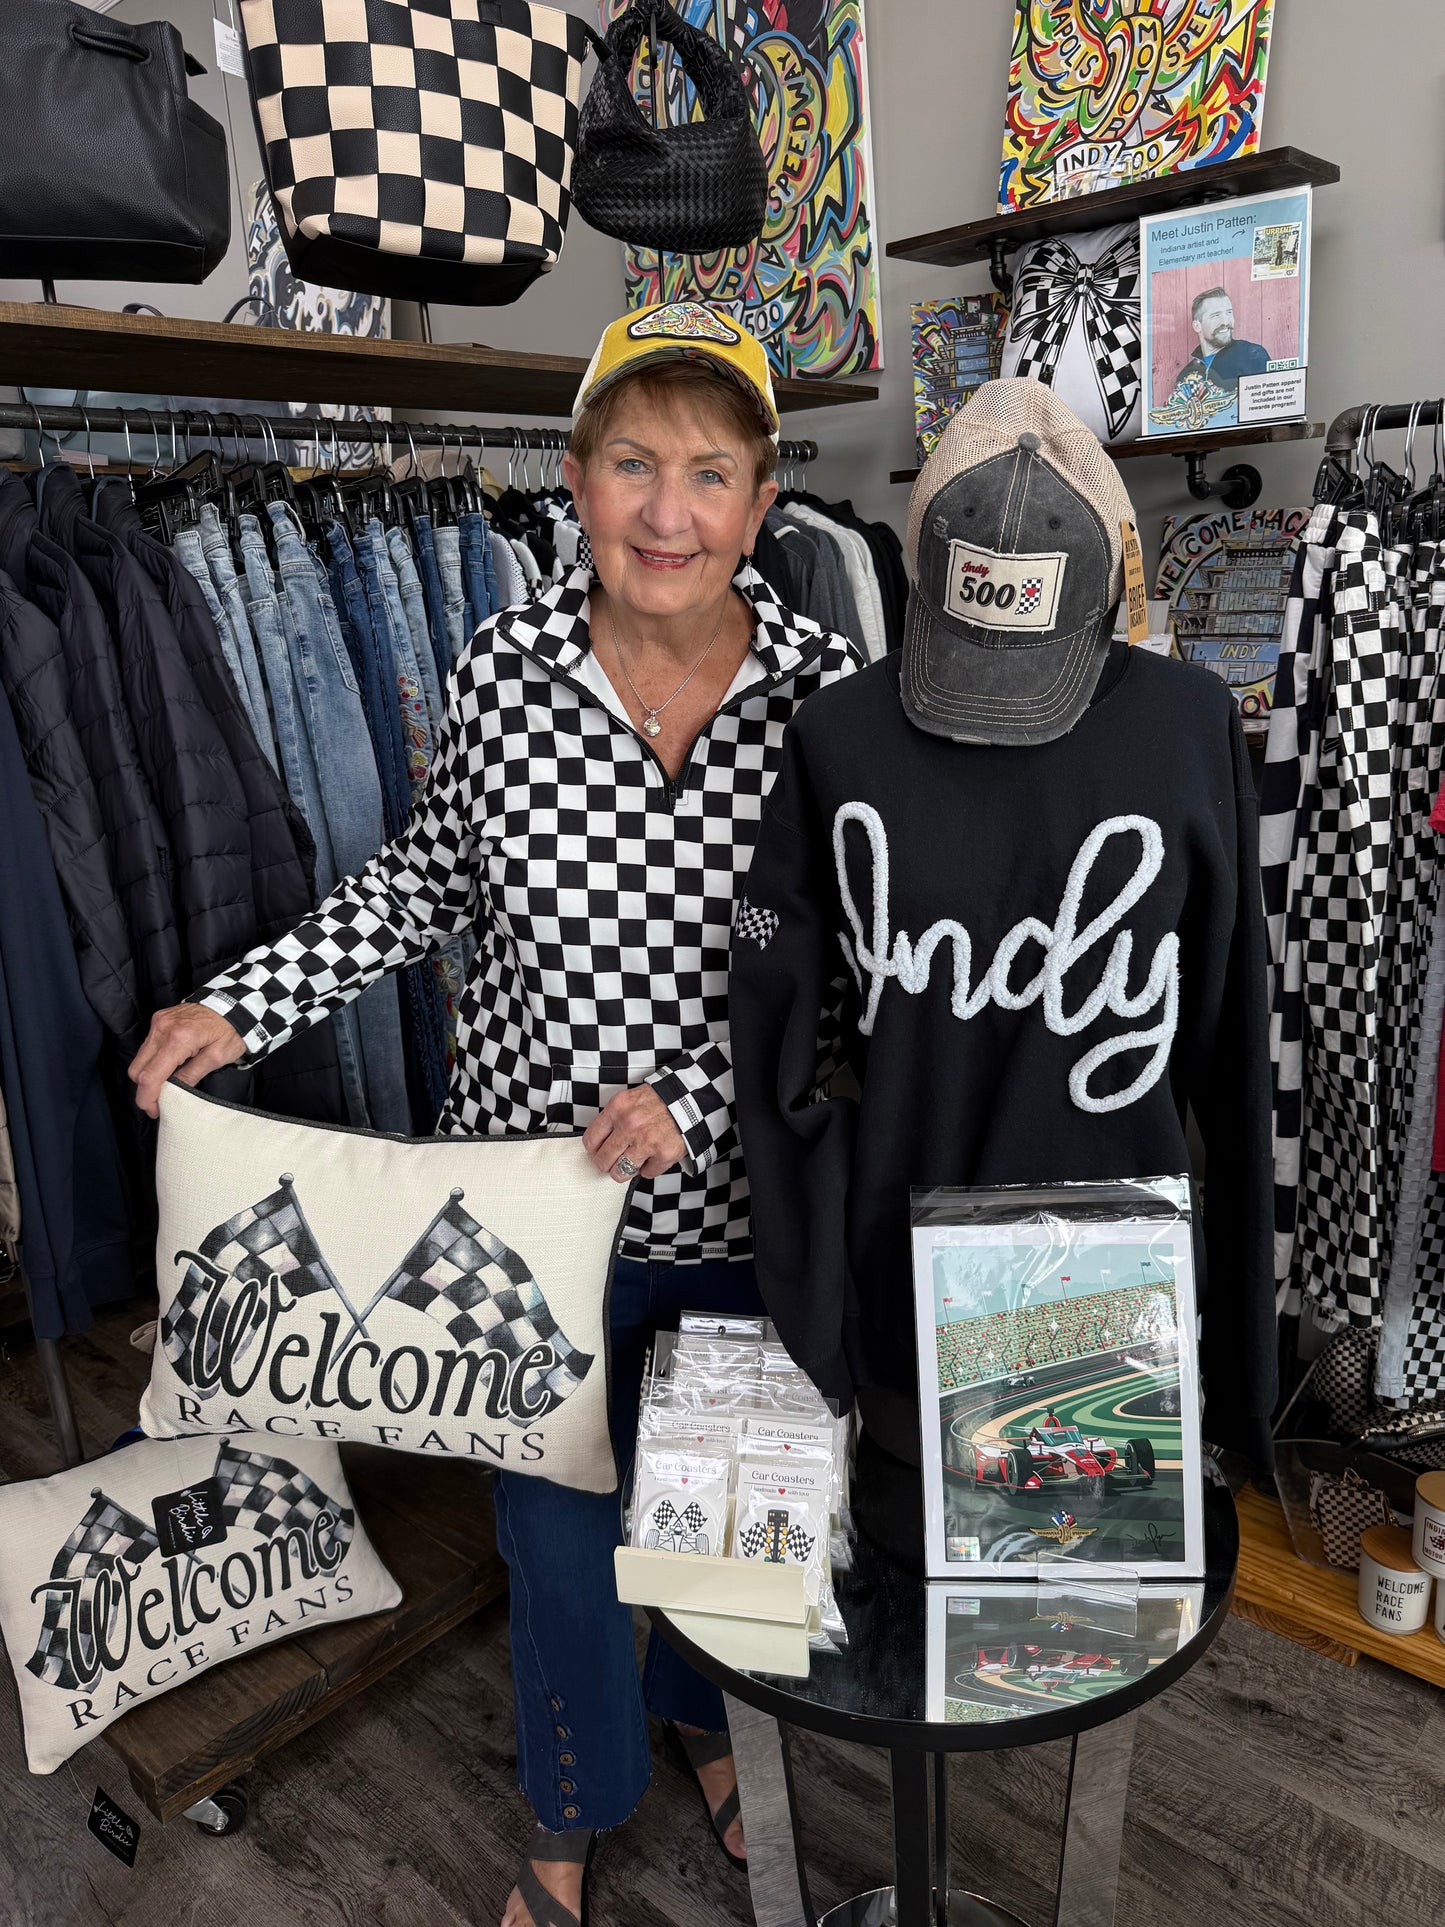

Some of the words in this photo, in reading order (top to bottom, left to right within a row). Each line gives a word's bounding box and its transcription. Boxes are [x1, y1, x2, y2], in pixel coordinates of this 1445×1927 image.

[1100, 21, 1158, 139] MOTOR
[768, 51, 812, 214] SPEEDWAY
[1062, 143, 1117, 173] INDY
[1151, 227, 1179, 242] Meet
[1181, 221, 1214, 237] Justin
[1216, 214, 1257, 230] Patten:
[1158, 253, 1196, 266] Elementary
[1196, 252, 1206, 260] art
[1206, 246, 1234, 258] teacher!
[1160, 242, 1186, 254] Indiana
[1187, 240, 1205, 250] artist
[1205, 237, 1220, 246] and
[745, 303, 781, 336] 500
[1244, 383, 1261, 391] Justin
[1281, 378, 1302, 387] apparel
[1262, 389, 1274, 397] gifts
[1252, 396, 1276, 404] included
[1271, 400, 1297, 410] program!
[1154, 511, 1246, 601] WELCOME
[961, 560, 991, 578] Indy
[959, 575, 1017, 610] 500
[1219, 643, 1262, 660] INDY
[832, 801, 1181, 1114] Indy
[174, 1250, 554, 1421] Welcome
[176, 1393, 345, 1440] RACE
[372, 1424, 546, 1461] FANS
[757, 1426, 776, 1436] Car
[777, 1428, 820, 1441] Coasters
[655, 1460, 673, 1470] Car
[674, 1463, 717, 1475] Coasters
[751, 1470, 770, 1481] Car
[771, 1473, 815, 1485] Coasters
[188, 1491, 209, 1528] Little
[169, 1503, 197, 1543] Birdie
[1377, 1575, 1426, 1595] WELCOME
[31, 1511, 342, 1684] Welcome
[1376, 1590, 1405, 1609] RACE
[1375, 1603, 1402, 1622] FANS
[66, 1640, 210, 1730] RACE
[226, 1574, 354, 1648] FANS
